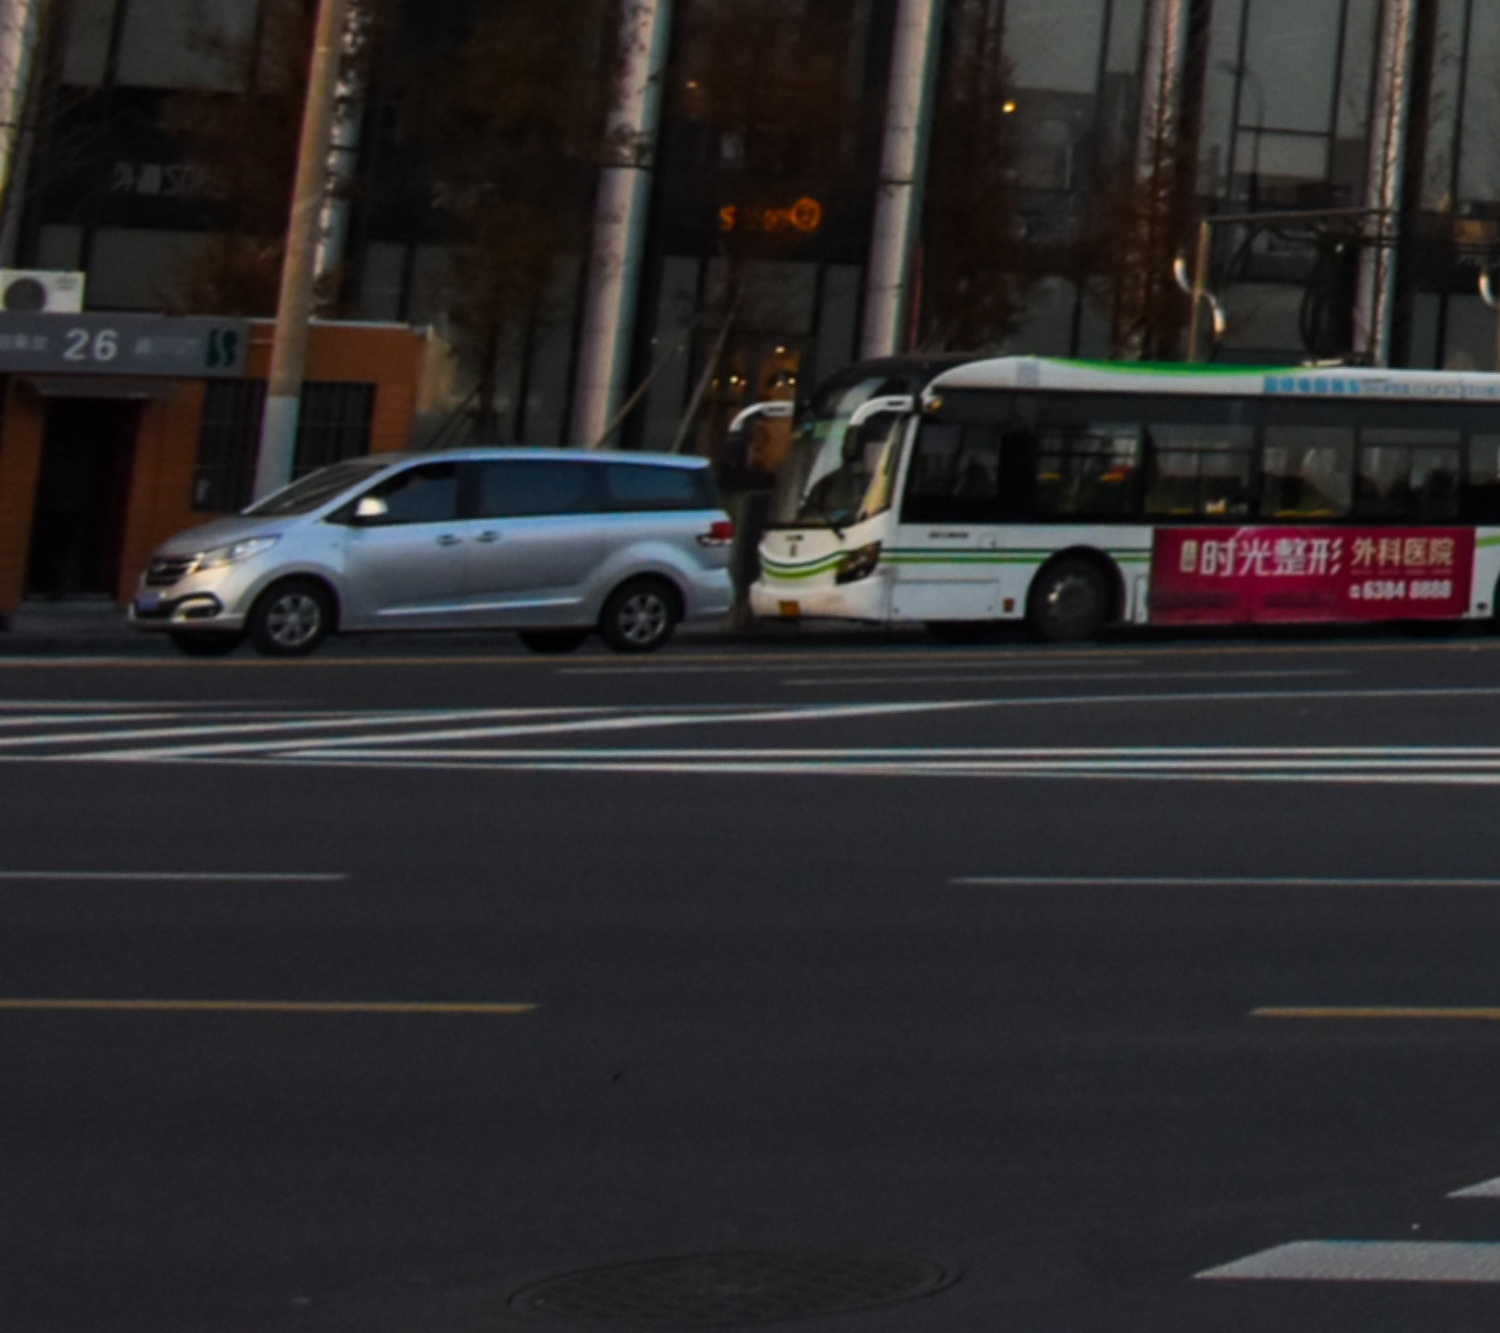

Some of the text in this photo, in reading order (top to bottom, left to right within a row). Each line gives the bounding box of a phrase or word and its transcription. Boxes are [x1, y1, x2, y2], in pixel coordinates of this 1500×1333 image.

[62, 328, 118, 361] 26
[1200, 537, 1343, 577] 时光整形
[1351, 537, 1455, 567] 外科医院
